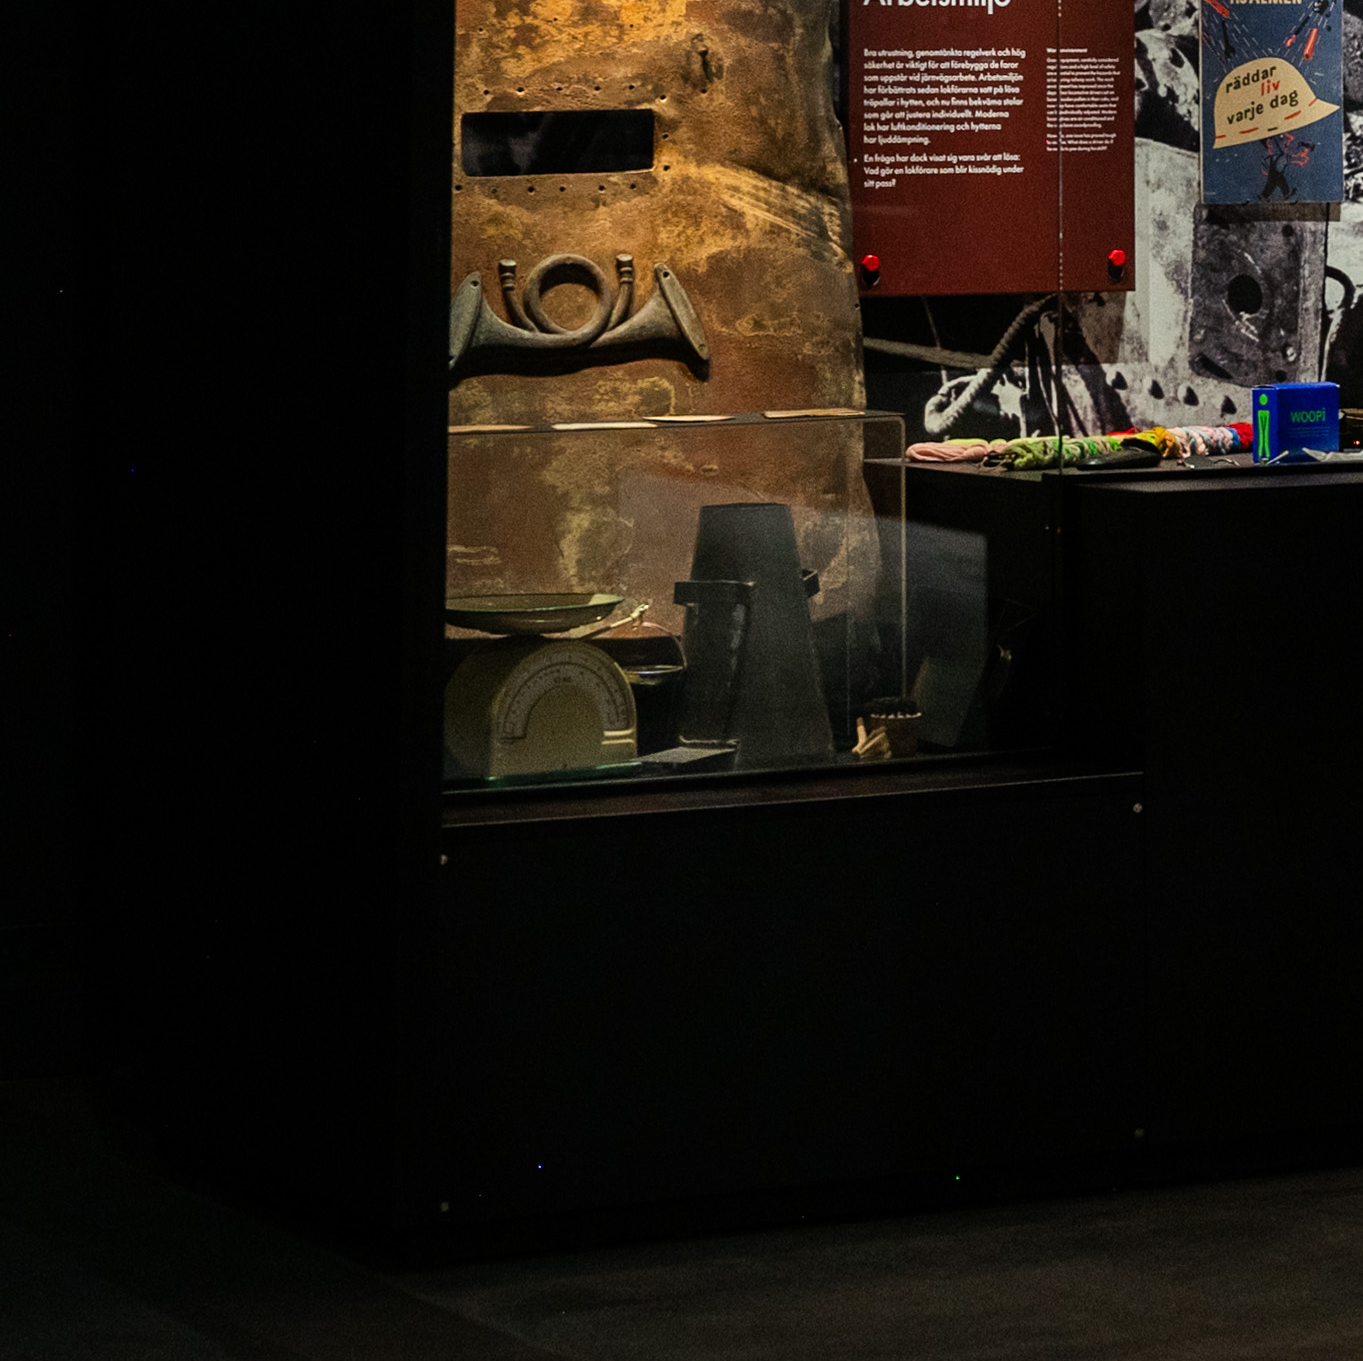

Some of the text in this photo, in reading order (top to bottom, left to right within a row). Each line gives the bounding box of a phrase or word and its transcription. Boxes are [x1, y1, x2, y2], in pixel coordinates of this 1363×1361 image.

[1225, 65, 1277, 94] räddar
[1260, 79, 1281, 96] liv
[1227, 90, 1298, 125] varje dag
